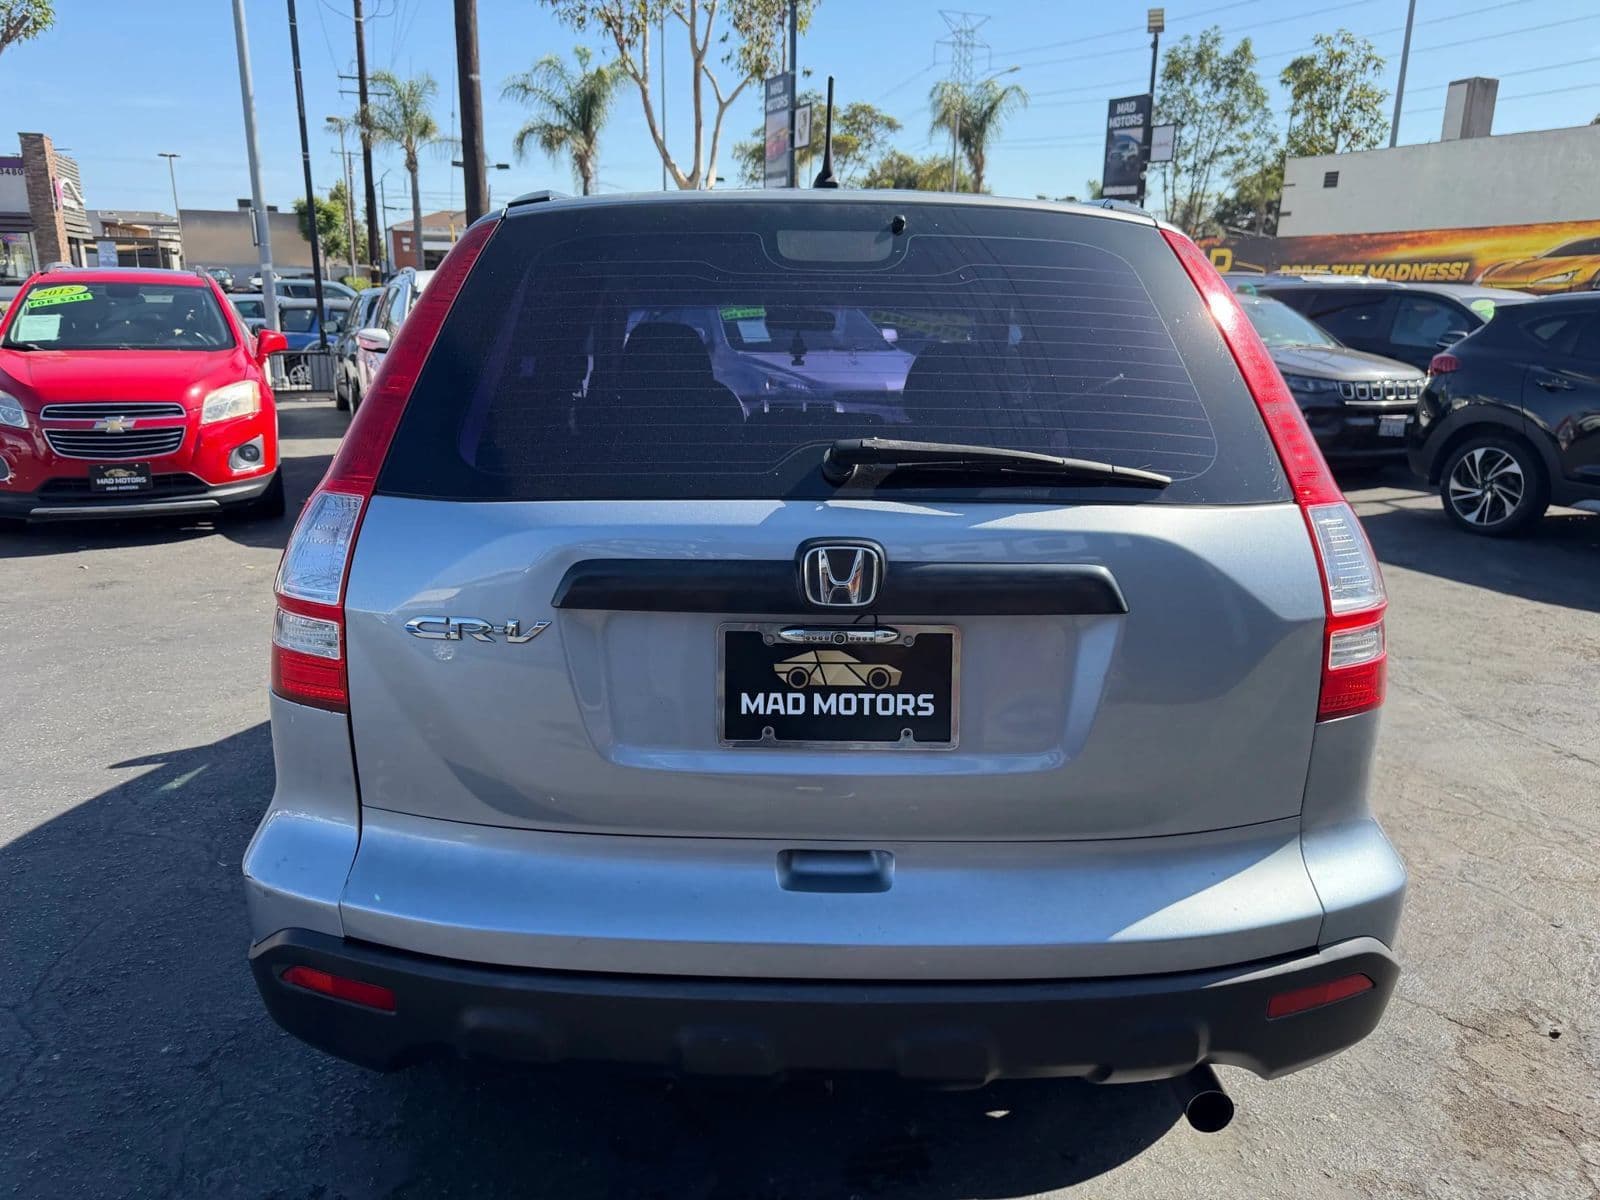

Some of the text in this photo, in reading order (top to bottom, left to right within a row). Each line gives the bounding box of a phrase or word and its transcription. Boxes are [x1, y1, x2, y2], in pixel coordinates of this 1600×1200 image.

[1116, 101, 1136, 113] MAD
[1109, 114, 1143, 127] MOTORS
[1331, 264, 1364, 277] THE
[1368, 261, 1470, 281] MADNESS!
[30, 294, 89, 307] FOR SALE
[403, 614, 553, 644] CR-V
[740, 692, 935, 717] MAD MOTORS
